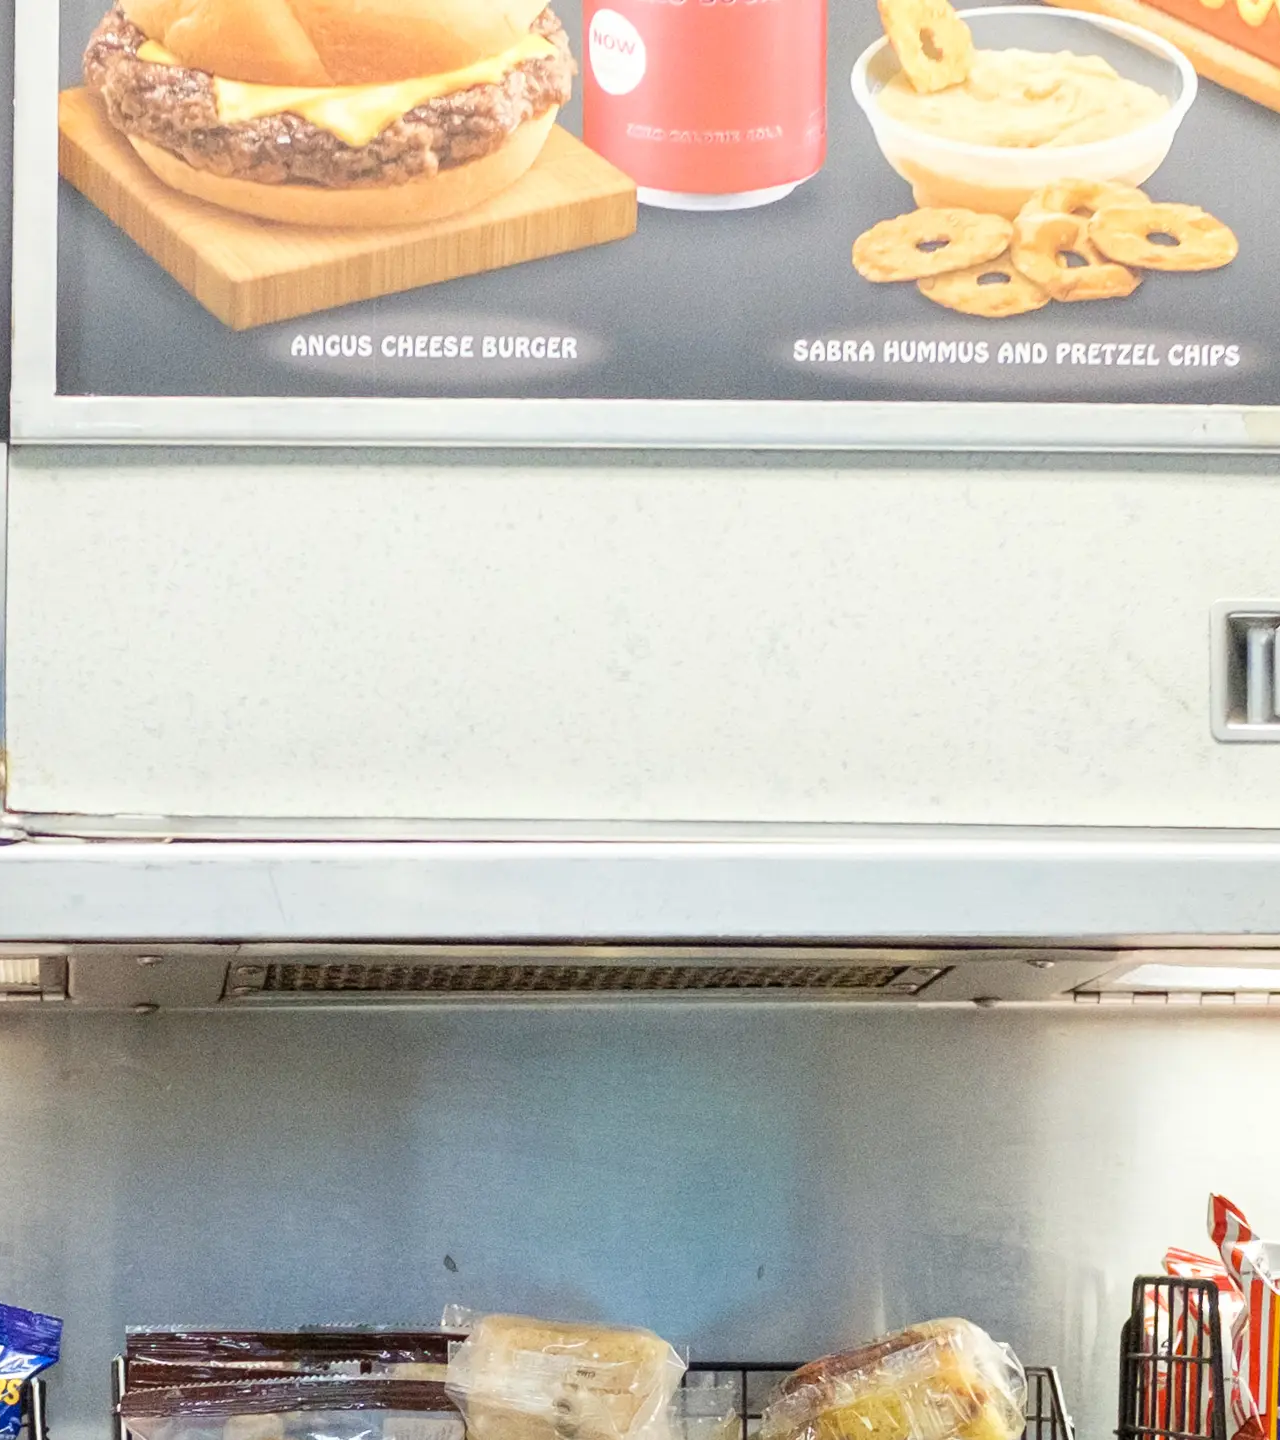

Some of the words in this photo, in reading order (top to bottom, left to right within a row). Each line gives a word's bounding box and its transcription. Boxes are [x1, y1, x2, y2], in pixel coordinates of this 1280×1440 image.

[291, 334, 374, 359] ANGUS
[381, 334, 474, 359] CHEESE
[481, 335, 578, 361] BURGER
[793, 339, 875, 363] SABRA
[883, 340, 989, 364] HUMMUS
[997, 341, 1048, 365] AND
[1056, 342, 1160, 368] PRETZEL
[1168, 343, 1241, 369] CHIPS
